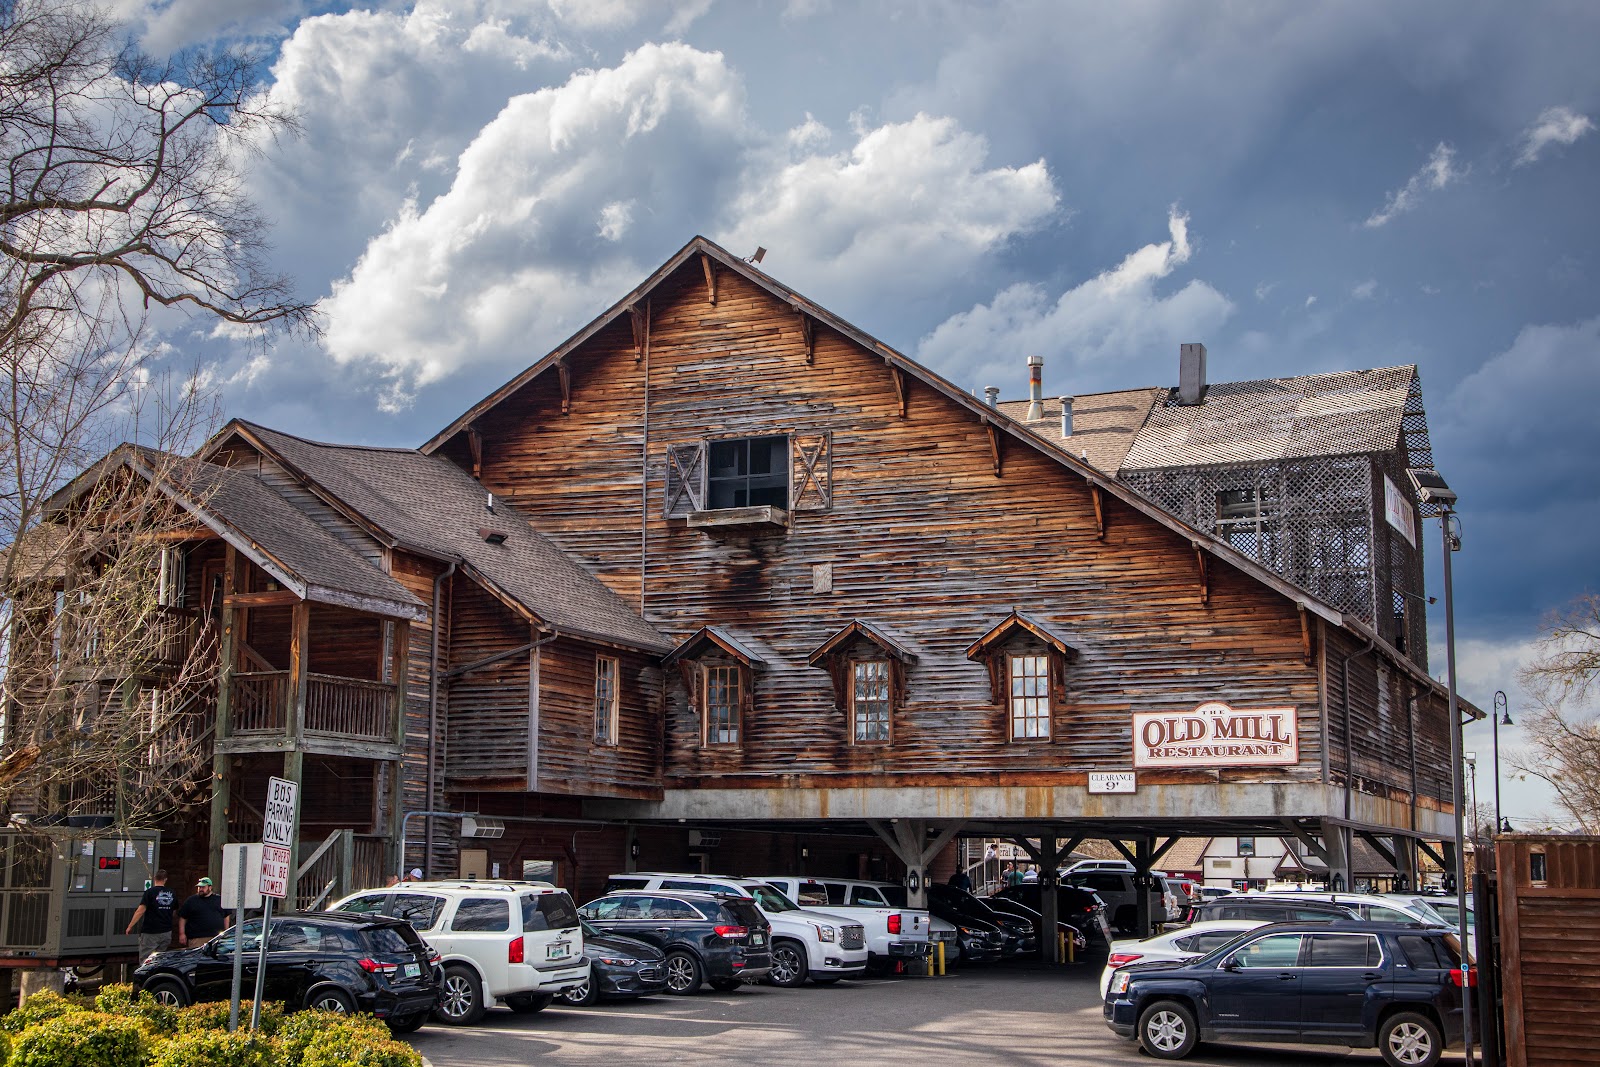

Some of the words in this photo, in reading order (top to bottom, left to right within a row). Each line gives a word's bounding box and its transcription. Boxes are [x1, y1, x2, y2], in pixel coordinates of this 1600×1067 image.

[1142, 717, 1207, 748] OLD
[1211, 714, 1291, 746] MILL
[1148, 744, 1282, 758] RESTAURANT
[273, 783, 292, 803] BUS
[268, 802, 293, 823] PARKING
[265, 822, 291, 842] ONLY
[263, 847, 272, 861] ALL
[262, 863, 275, 877] WILL
[279, 867, 287, 879] BE
[263, 879, 282, 894] TOWED
